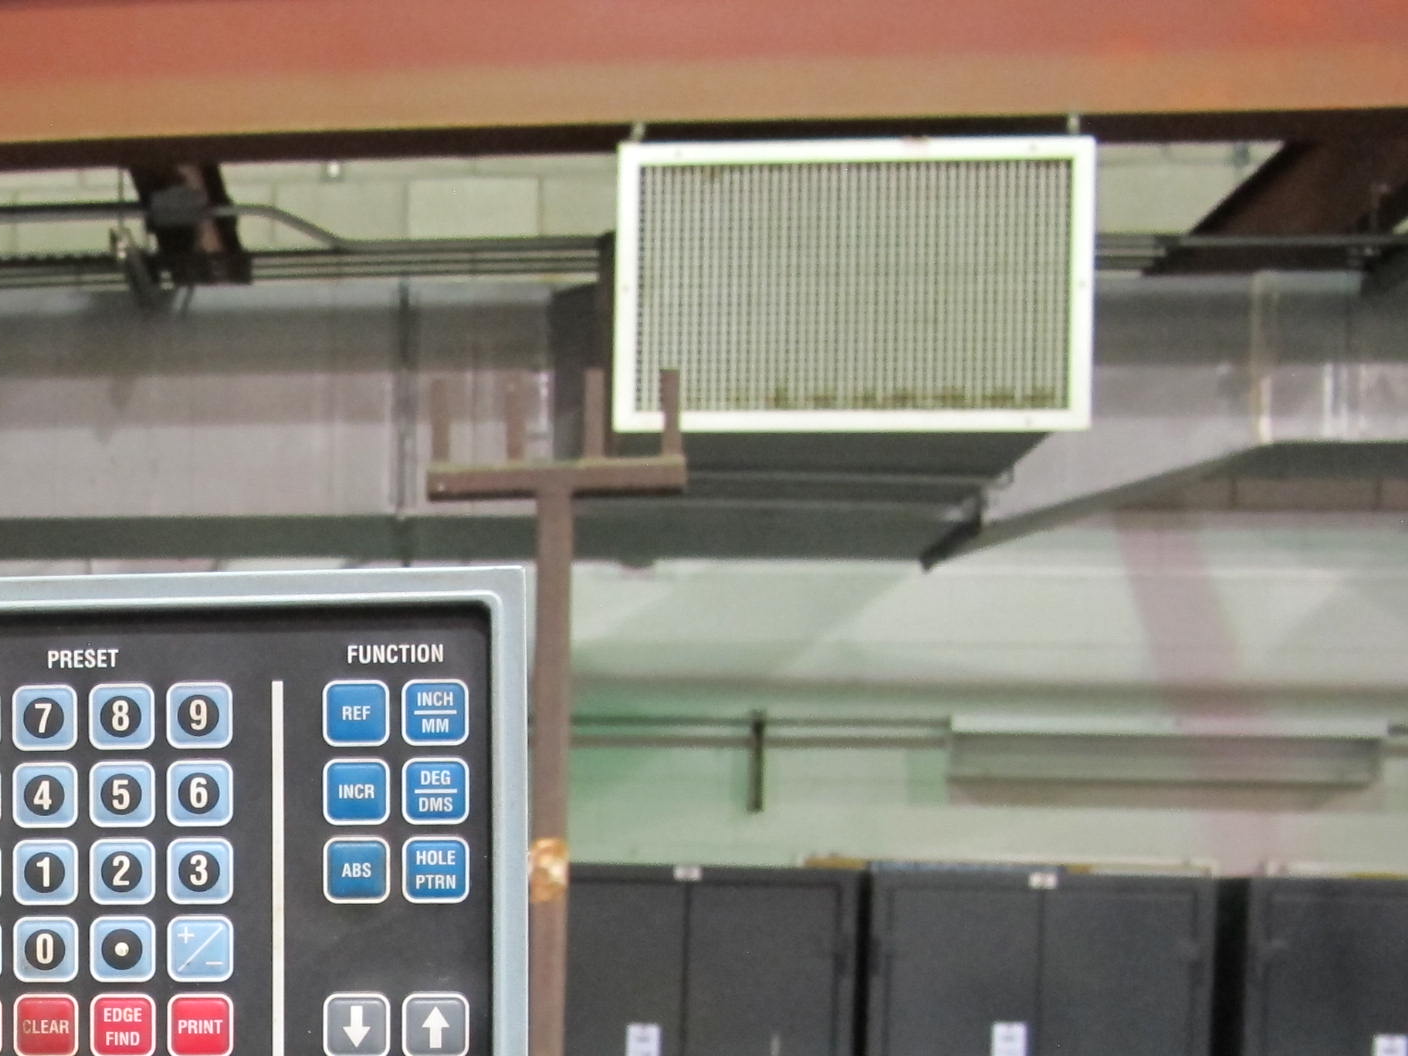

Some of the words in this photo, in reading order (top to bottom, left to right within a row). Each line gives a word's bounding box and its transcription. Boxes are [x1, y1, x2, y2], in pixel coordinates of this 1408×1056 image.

[48, 649, 118, 668] PRESET
[348, 644, 443, 663] FUNCTION
[418, 692, 453, 706] INCH
[35, 703, 52, 732] 7
[112, 701, 129, 731] 8
[189, 699, 207, 730] 9
[343, 706, 370, 720] REF
[422, 718, 449, 732] MM
[421, 770, 450, 784] DEG
[33, 780, 51, 810] 4
[112, 779, 130, 810] 5
[190, 777, 207, 808] 6
[339, 784, 374, 799] INCR
[419, 797, 453, 811] DMS
[417, 850, 455, 865] HOLE
[40, 857, 50, 887] 1
[112, 856, 130, 887] 2
[190, 855, 207, 886] 3
[342, 863, 371, 877] ABS
[416, 874, 456, 889] PTRN
[36, 933, 53, 963] 0
[104, 1008, 142, 1022] EDGE
[23, 1020, 69, 1034] CLEAR
[178, 1020, 223, 1034] PRINT
[106, 1032, 140, 1045] FIND
